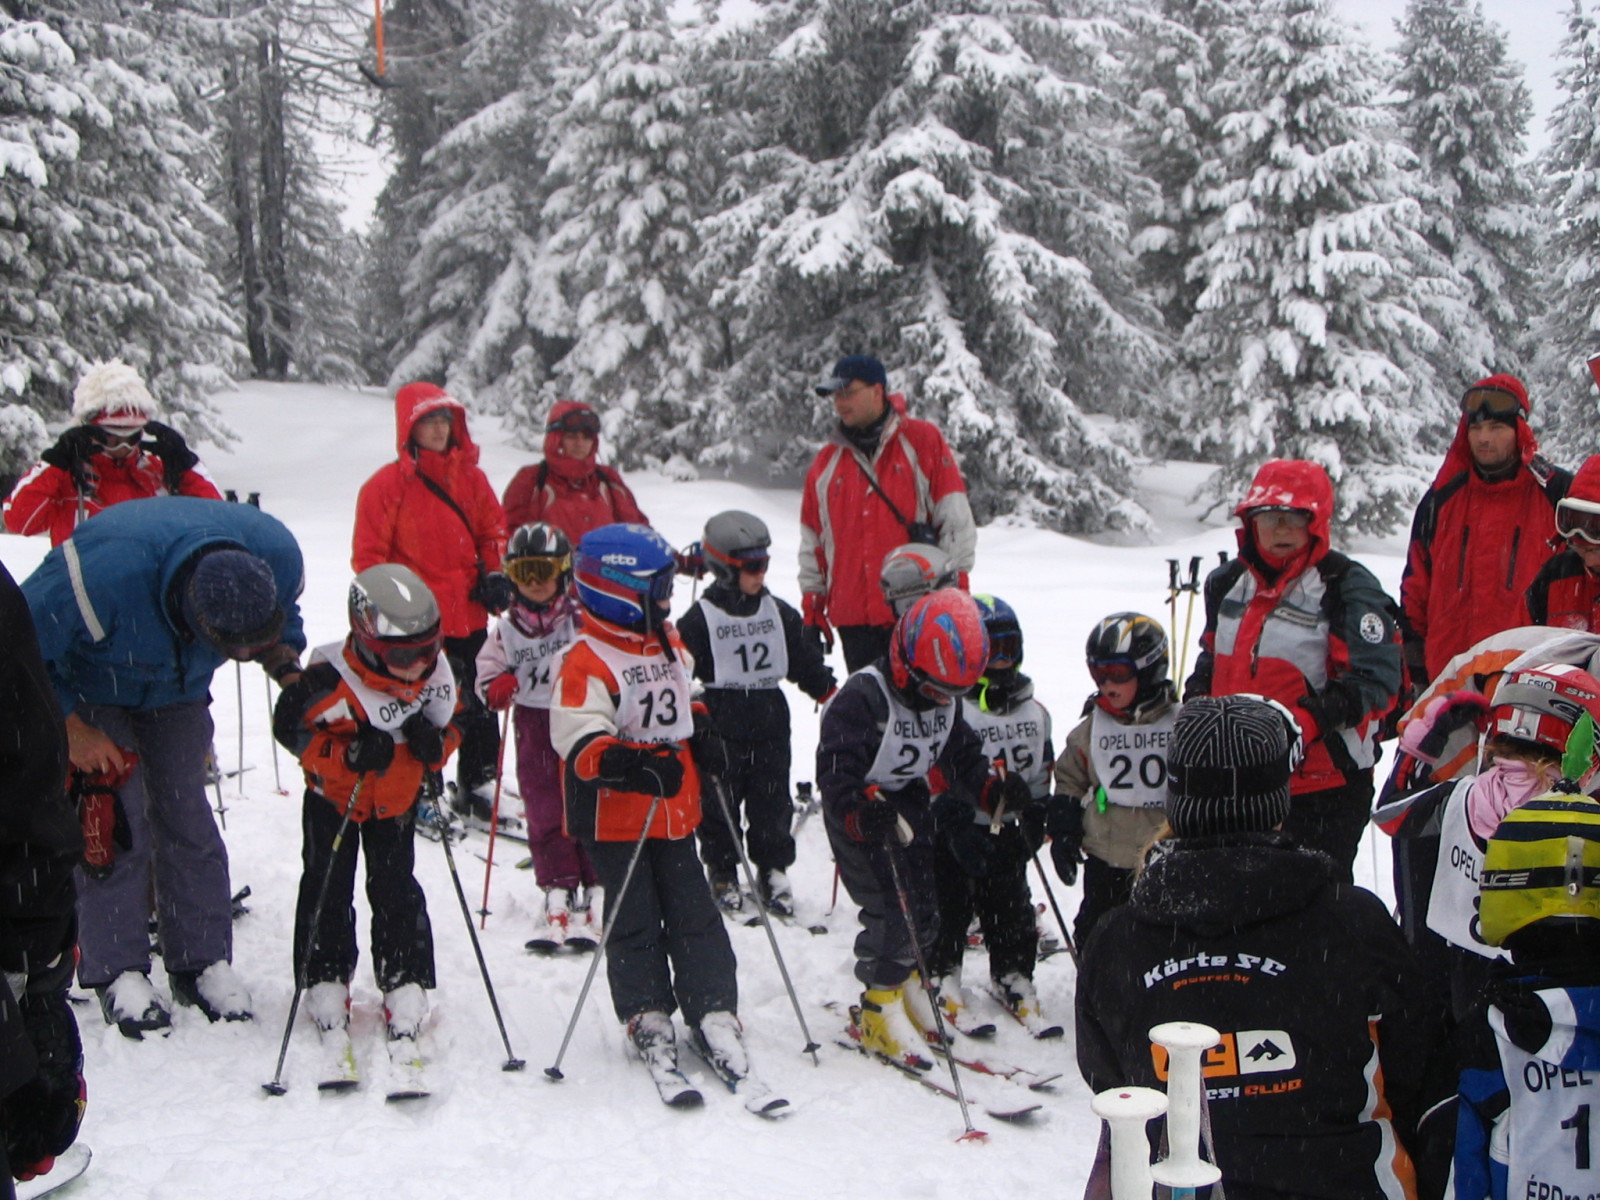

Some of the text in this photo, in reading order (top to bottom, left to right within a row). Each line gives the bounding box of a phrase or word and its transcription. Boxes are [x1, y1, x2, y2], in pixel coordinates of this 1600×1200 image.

[716, 624, 745, 640] OPEL
[514, 647, 538, 665] OPEL
[734, 642, 772, 673] 12
[622, 664, 651, 686] OPEL
[639, 688, 678, 729] 13
[1100, 734, 1131, 751] OPEL
[1109, 753, 1168, 789] 20
[1451, 845, 1478, 883] OPEL
[1143, 951, 1228, 989] Körte
[1172, 973, 1251, 991] powered by
[1523, 1060, 1594, 1093] OPEL
[1560, 1103, 1591, 1170] 1
